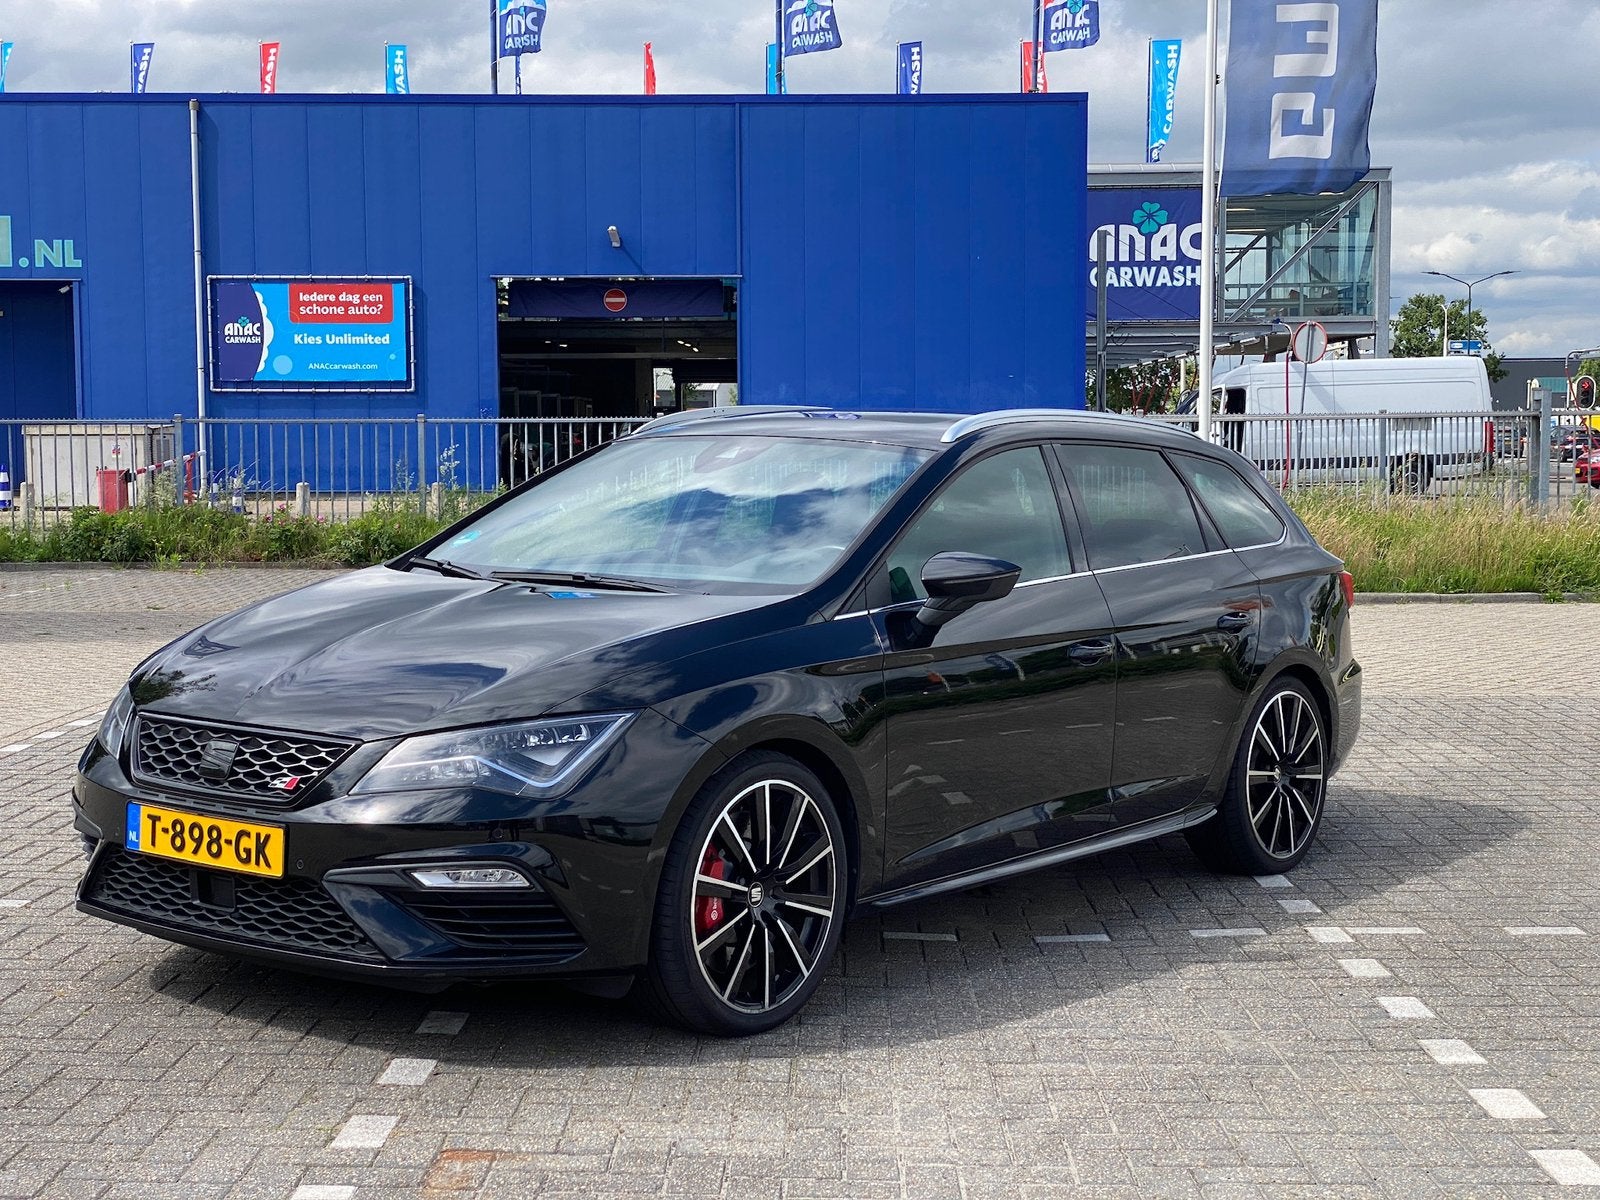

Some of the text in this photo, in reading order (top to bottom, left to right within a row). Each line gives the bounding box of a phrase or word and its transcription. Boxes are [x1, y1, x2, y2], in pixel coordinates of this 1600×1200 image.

[1163, 44, 1179, 134] CARWASH
[1088, 222, 1202, 262] ANAC
[1089, 265, 1201, 288] CARWASH
[299, 292, 383, 304] Iedere dag een
[299, 303, 384, 315] schone auto?
[224, 322, 261, 336] ANAC
[225, 336, 262, 344] CARWASH
[293, 333, 390, 345] Kies Unlimited
[308, 362, 378, 371] ANACcarwash.com
[128, 830, 139, 842] NL
[146, 813, 273, 870] T-898-GK
